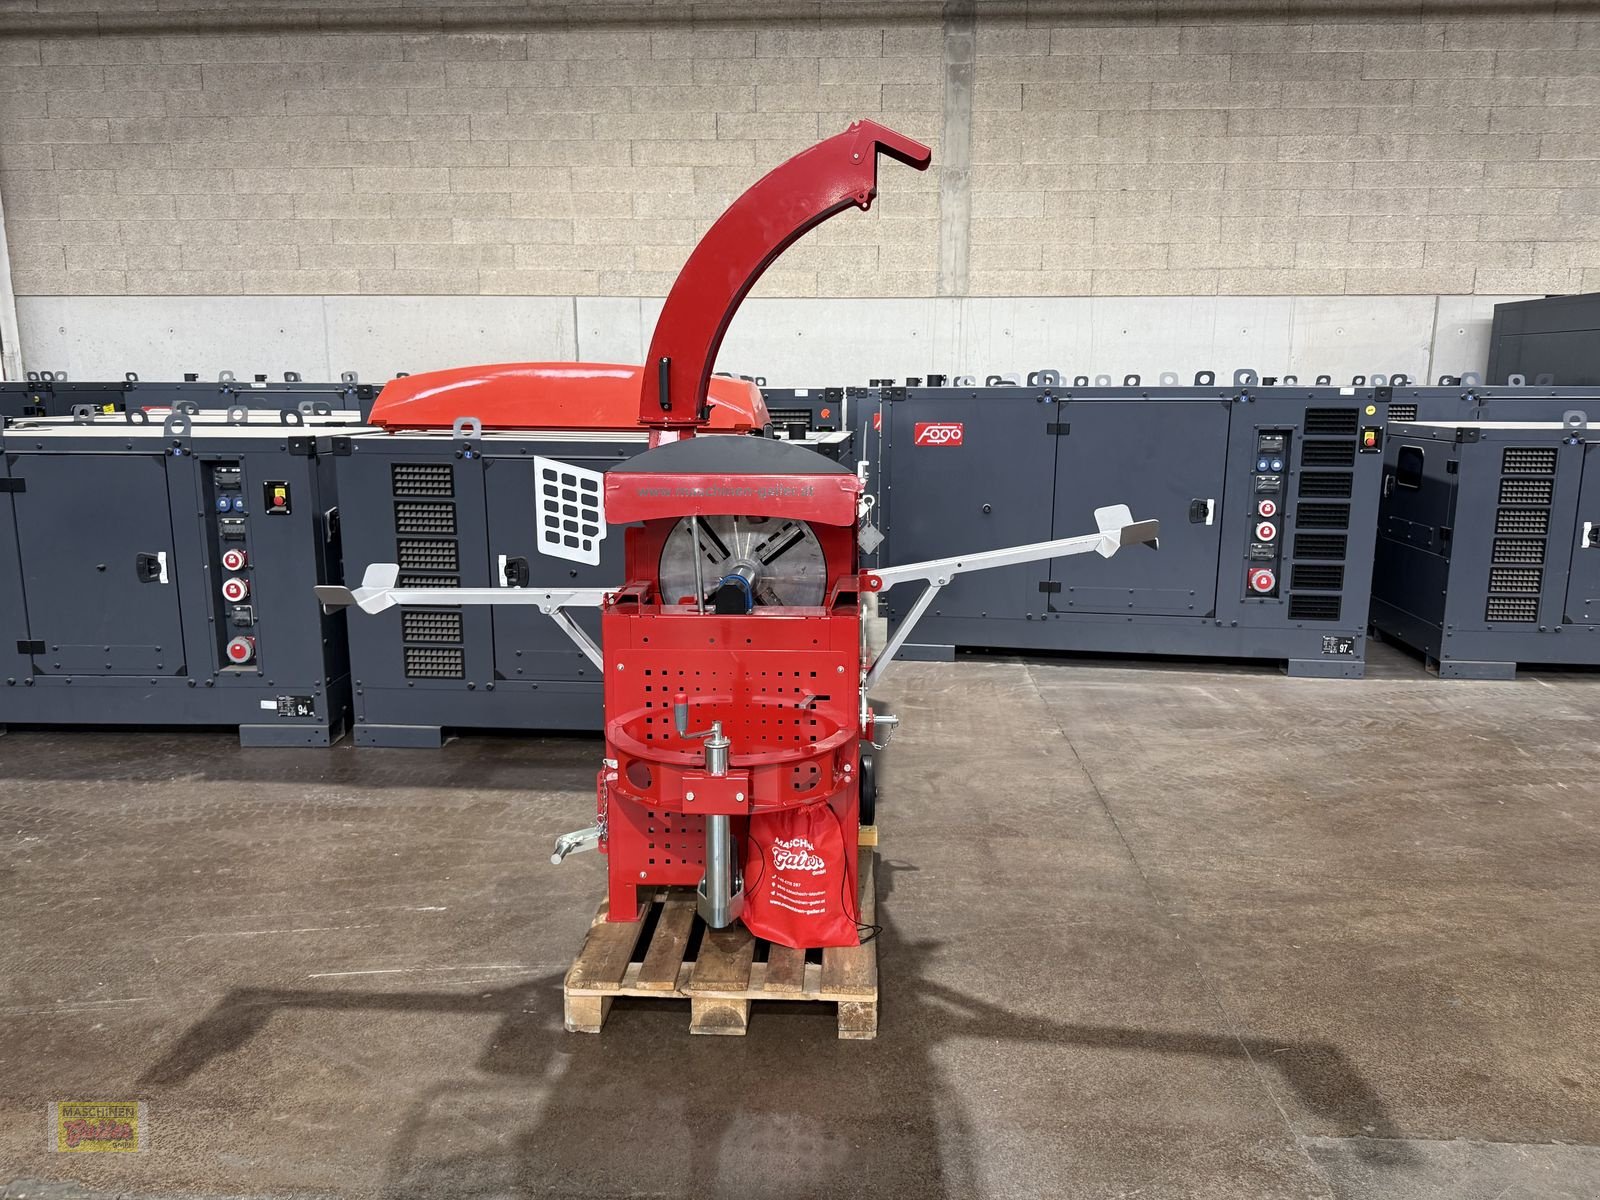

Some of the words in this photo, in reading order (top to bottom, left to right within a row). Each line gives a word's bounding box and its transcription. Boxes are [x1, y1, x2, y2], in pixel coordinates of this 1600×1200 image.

[917, 425, 962, 443] Fogo
[1339, 644, 1348, 653] 97
[297, 704, 308, 715] 94
